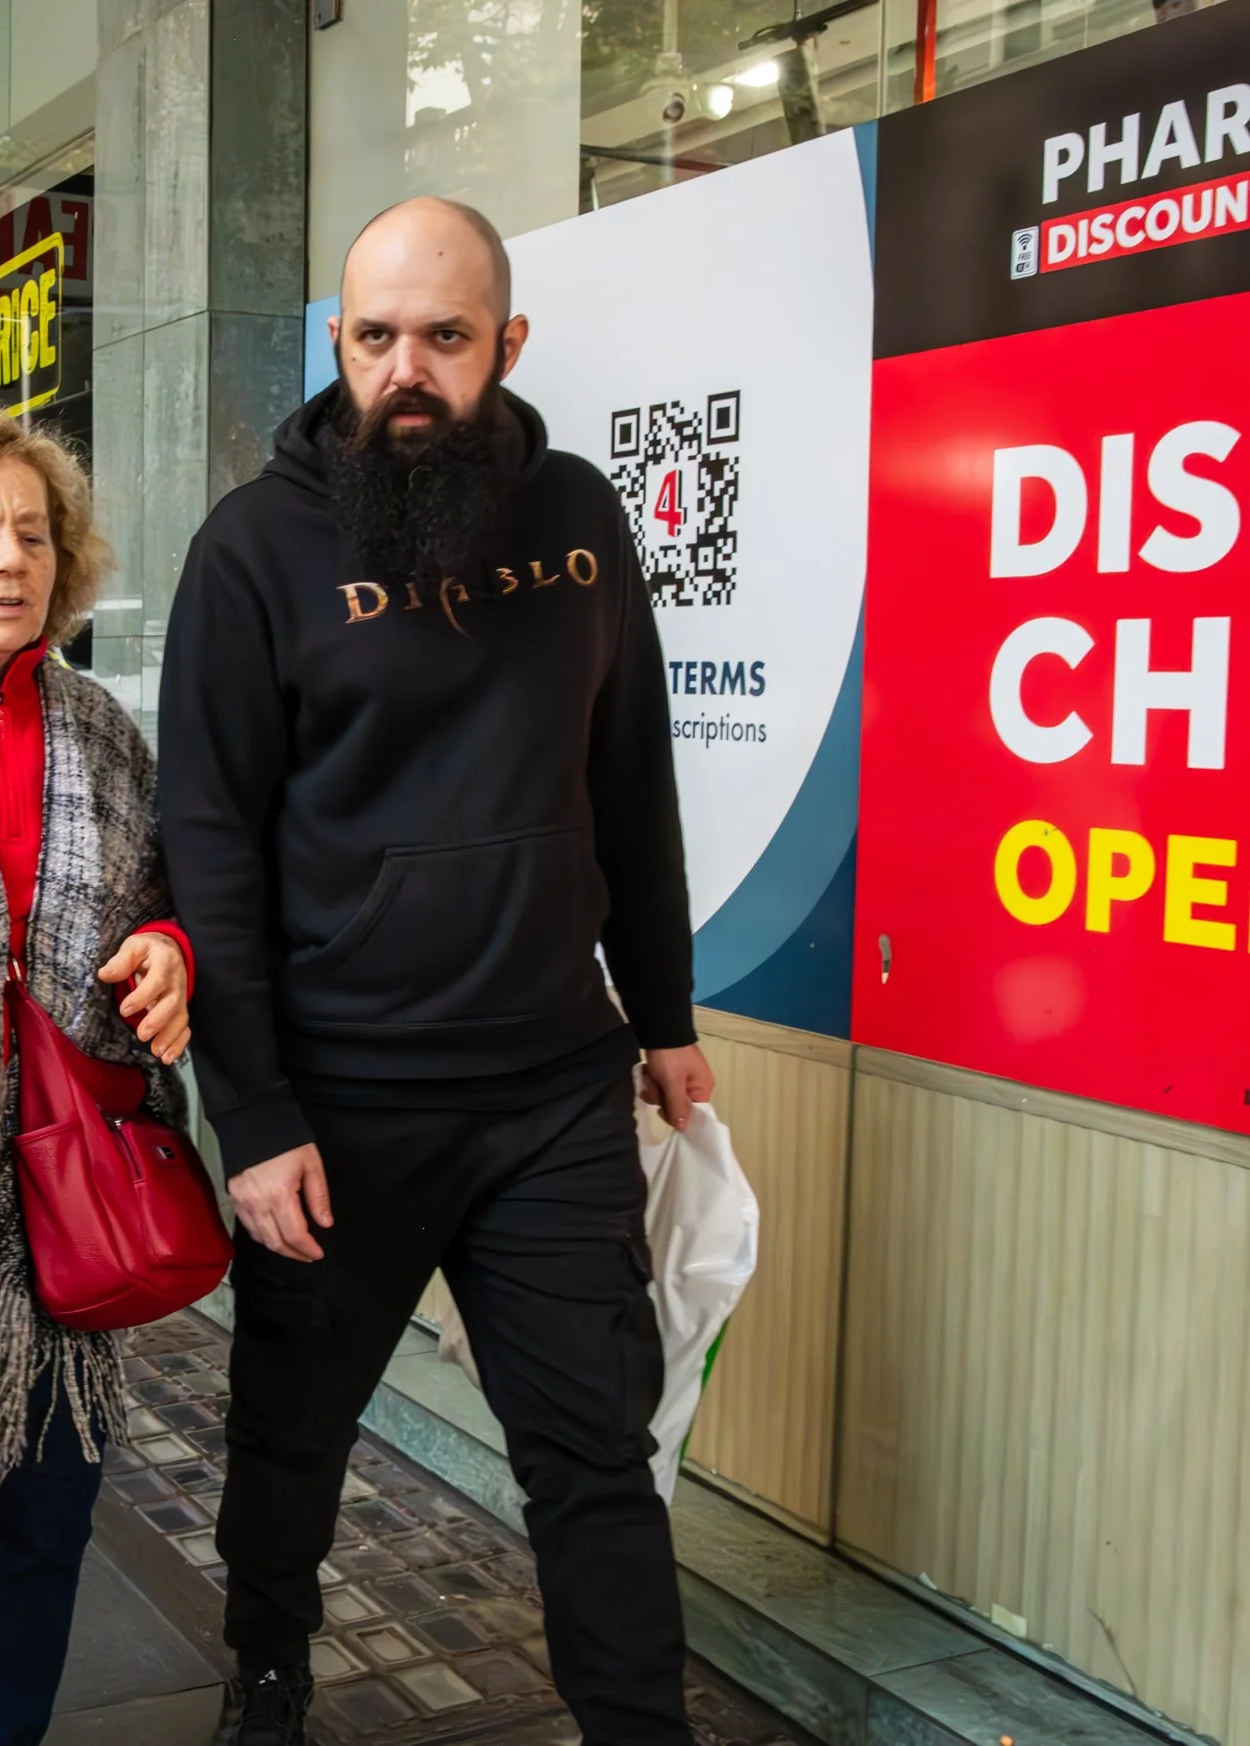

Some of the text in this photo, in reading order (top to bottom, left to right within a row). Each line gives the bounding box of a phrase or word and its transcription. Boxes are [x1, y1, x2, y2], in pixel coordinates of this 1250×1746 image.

[1047, 179, 1249, 265] DISCOUN
[990, 420, 1241, 578] DIS
[669, 660, 766, 697] TERMS
[672, 713, 767, 749] scriptions
[989, 616, 1231, 770] CH
[994, 819, 1250, 951] OPE
